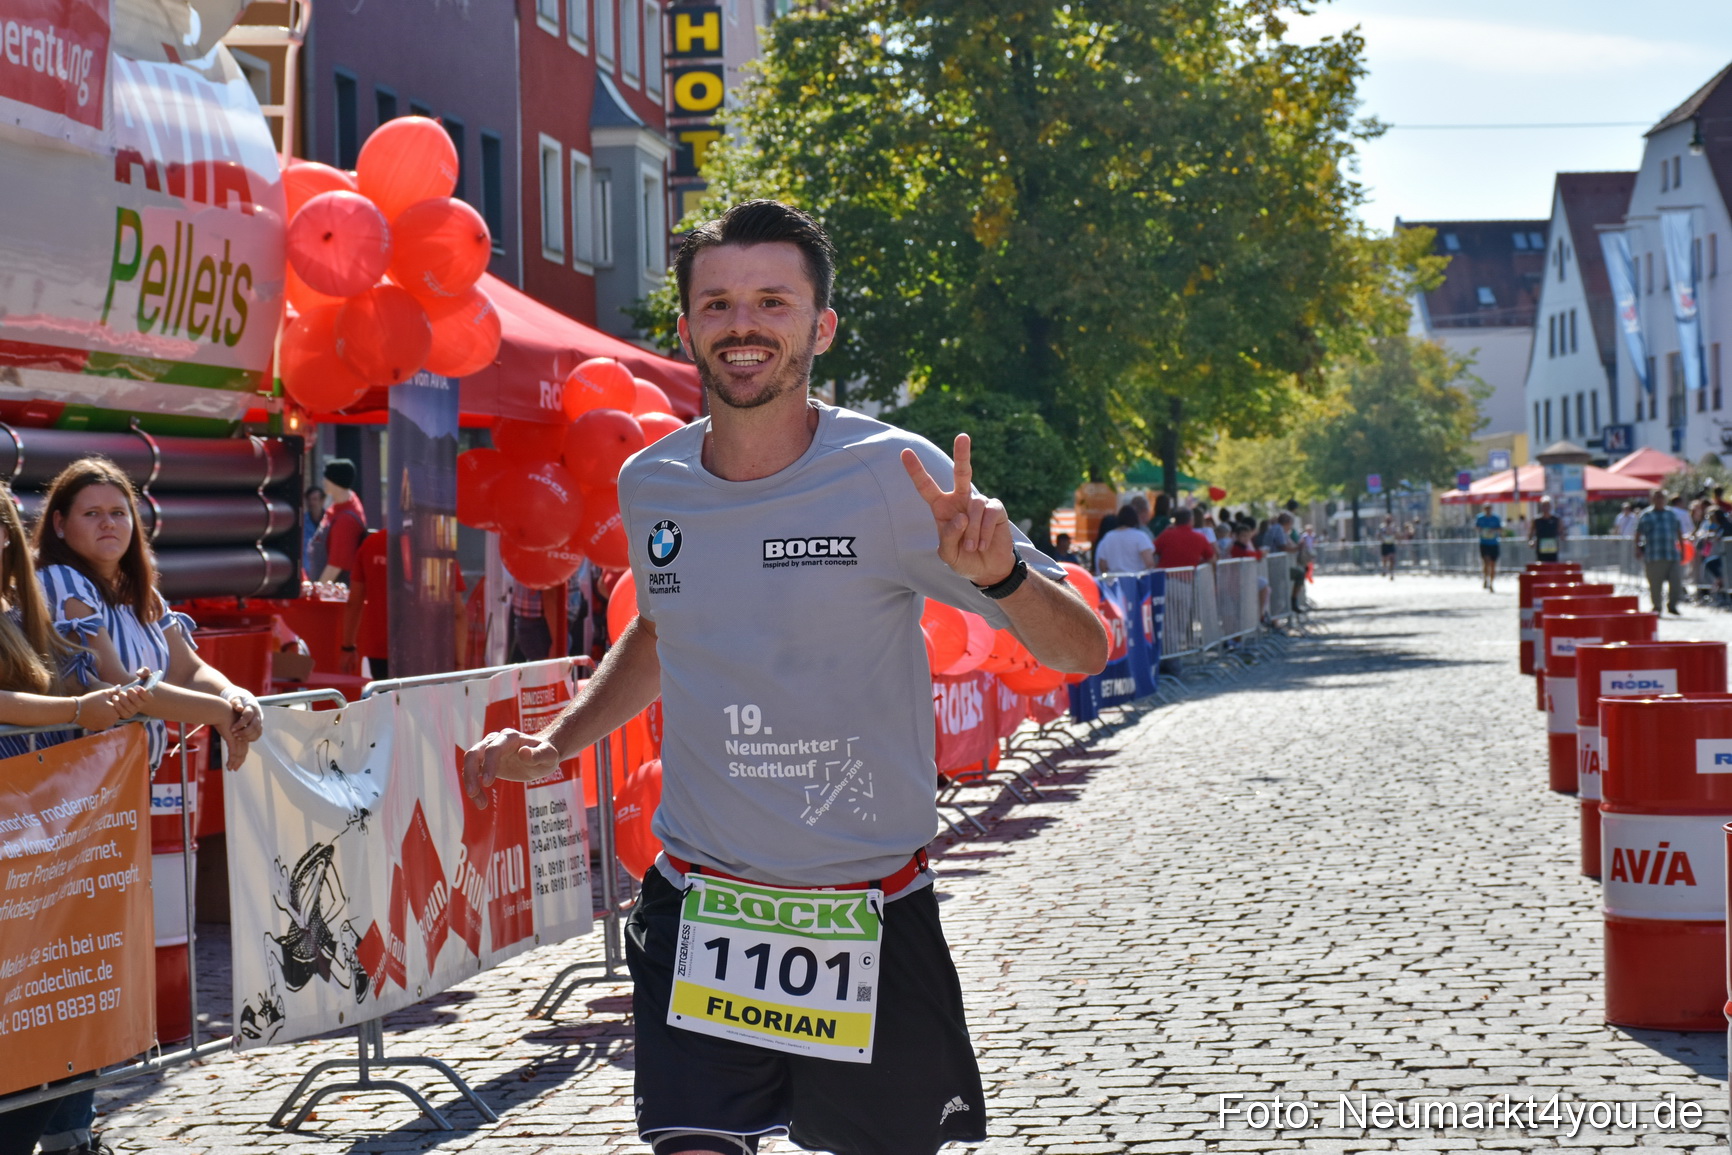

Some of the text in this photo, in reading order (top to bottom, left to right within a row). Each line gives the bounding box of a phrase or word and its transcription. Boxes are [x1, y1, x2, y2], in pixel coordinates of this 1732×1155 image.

[0, 19, 93, 107] eratung
[674, 12, 724, 216] HOT
[101, 206, 253, 347] Pellets
[651, 521, 680, 537] BMW
[763, 537, 857, 560] BOCK
[763, 560, 790, 569] inspired
[824, 558, 857, 566] concepts
[649, 573, 681, 585] PARTL
[649, 585, 681, 595] Neumarkt
[723, 704, 772, 735] 19.
[725, 739, 839, 756] Neumarkter
[728, 759, 817, 778] Stadtlauf
[806, 759, 864, 827] 16. September 2018
[700, 885, 863, 933] BOCK
[42, 938, 68, 963] sich
[71, 933, 94, 956] bei
[97, 931, 124, 950] uns:
[863, 956, 871, 966] C
[25, 959, 113, 998] codeclinic.de
[703, 936, 851, 1001] 1101
[12, 1003, 54, 1033] 09181
[56, 994, 96, 1021] 8833
[99, 987, 122, 1011] 897
[706, 996, 837, 1039] FLORIAN
